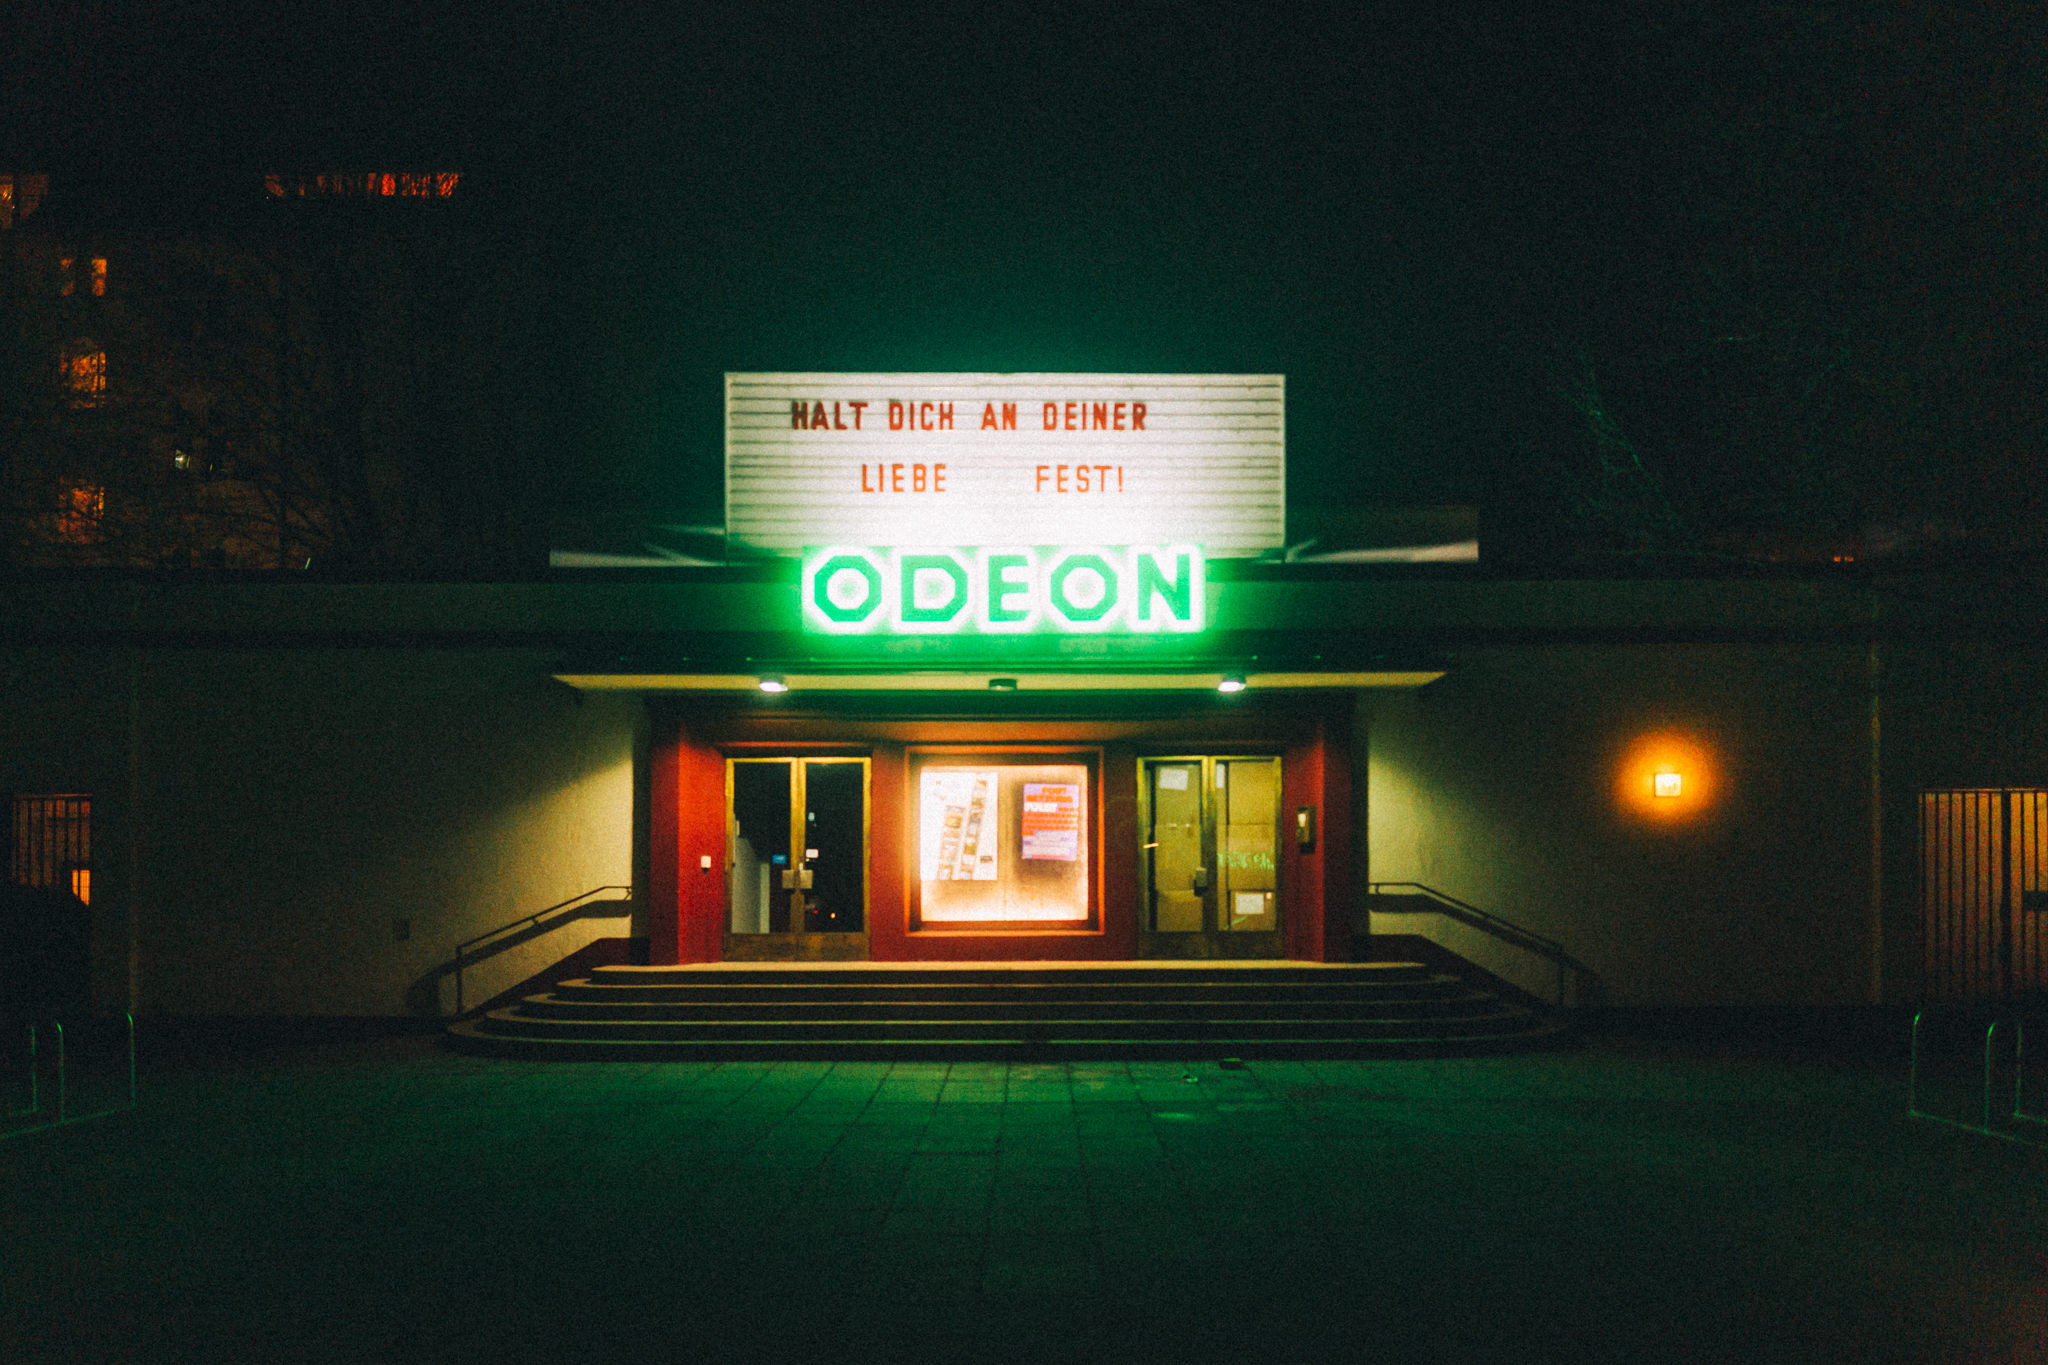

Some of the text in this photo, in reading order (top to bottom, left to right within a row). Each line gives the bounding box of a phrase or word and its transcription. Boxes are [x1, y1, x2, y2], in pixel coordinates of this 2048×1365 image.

[792, 402, 1147, 431] HALT DICH AN DEINER
[862, 463, 1123, 493] LIEBE FEST!
[813, 553, 1191, 622] ODEON
